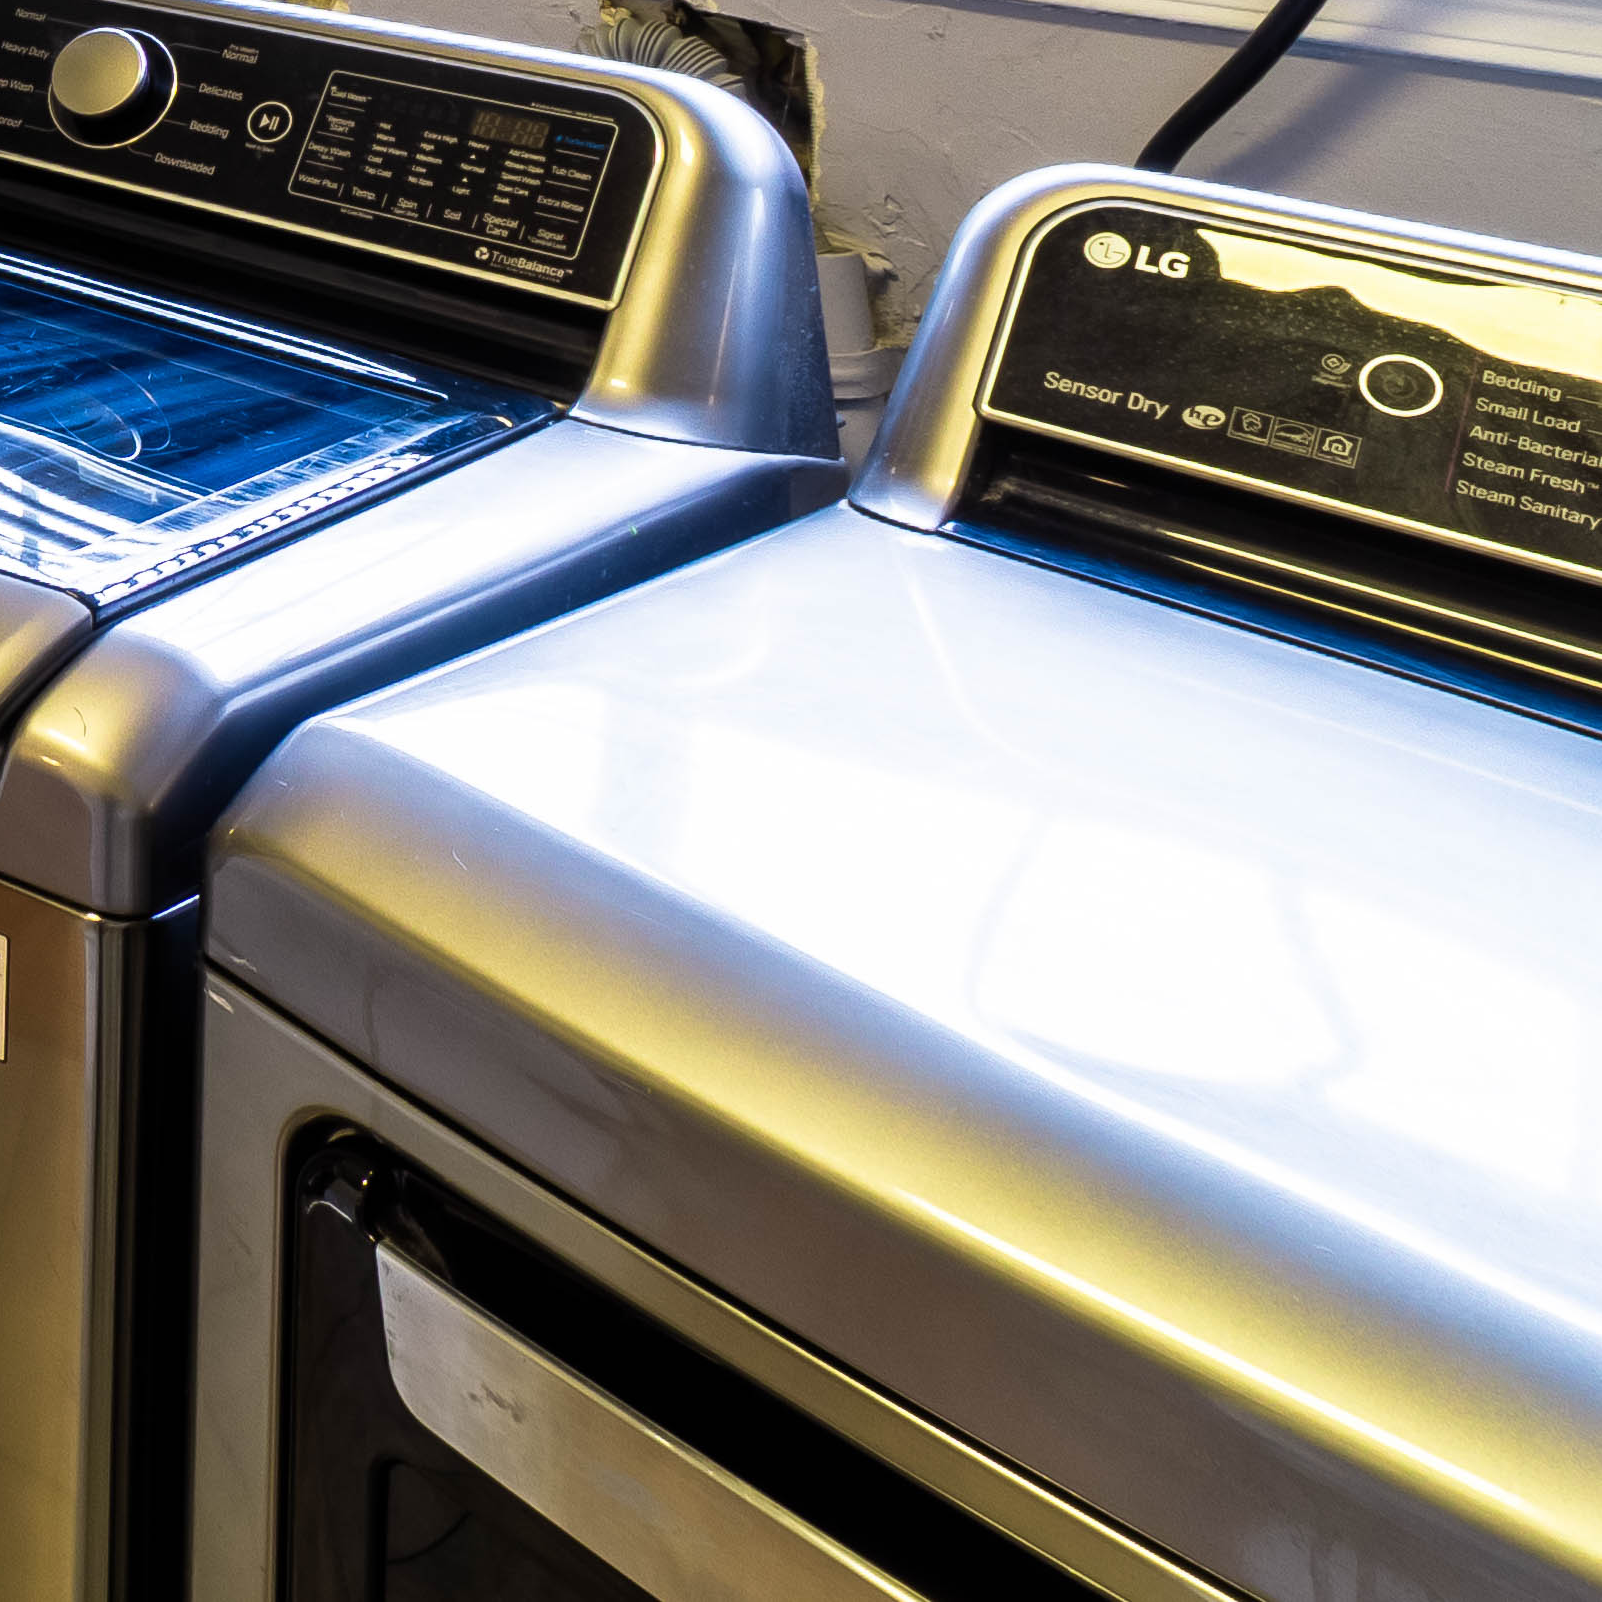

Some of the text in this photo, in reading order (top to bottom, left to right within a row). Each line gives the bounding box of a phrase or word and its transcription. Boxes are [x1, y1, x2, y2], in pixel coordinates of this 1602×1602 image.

[15, 7, 47, 22] Normal
[1, 41, 51, 60] Heavy Duty
[222, 49, 259, 64] Normal
[10, 79, 35, 93] Wash
[198, 82, 244, 101] Delicates
[189, 119, 230, 139] Bedding
[308, 141, 329, 153] Delay
[154, 152, 216, 176] Downloaded
[552, 165, 592, 181] Tub Clean
[298, 174, 321, 186] Water
[397, 197, 418, 210] Spin
[537, 195, 584, 213] Extra Rinse
[482, 212, 520, 229] Special
[486, 224, 509, 238] Care
[537, 228, 565, 242] Signal
[1134, 245, 1191, 279] LG
[1482, 370, 1562, 402] Bedding
[1043, 372, 1170, 420] Sensor Dry
[1476, 398, 1581, 433] Small Load
[1469, 425, 1602, 468] Anti-Bacterial
[1462, 452, 1525, 479] Steam
[1456, 479, 1602, 531] Steam Sanitary
